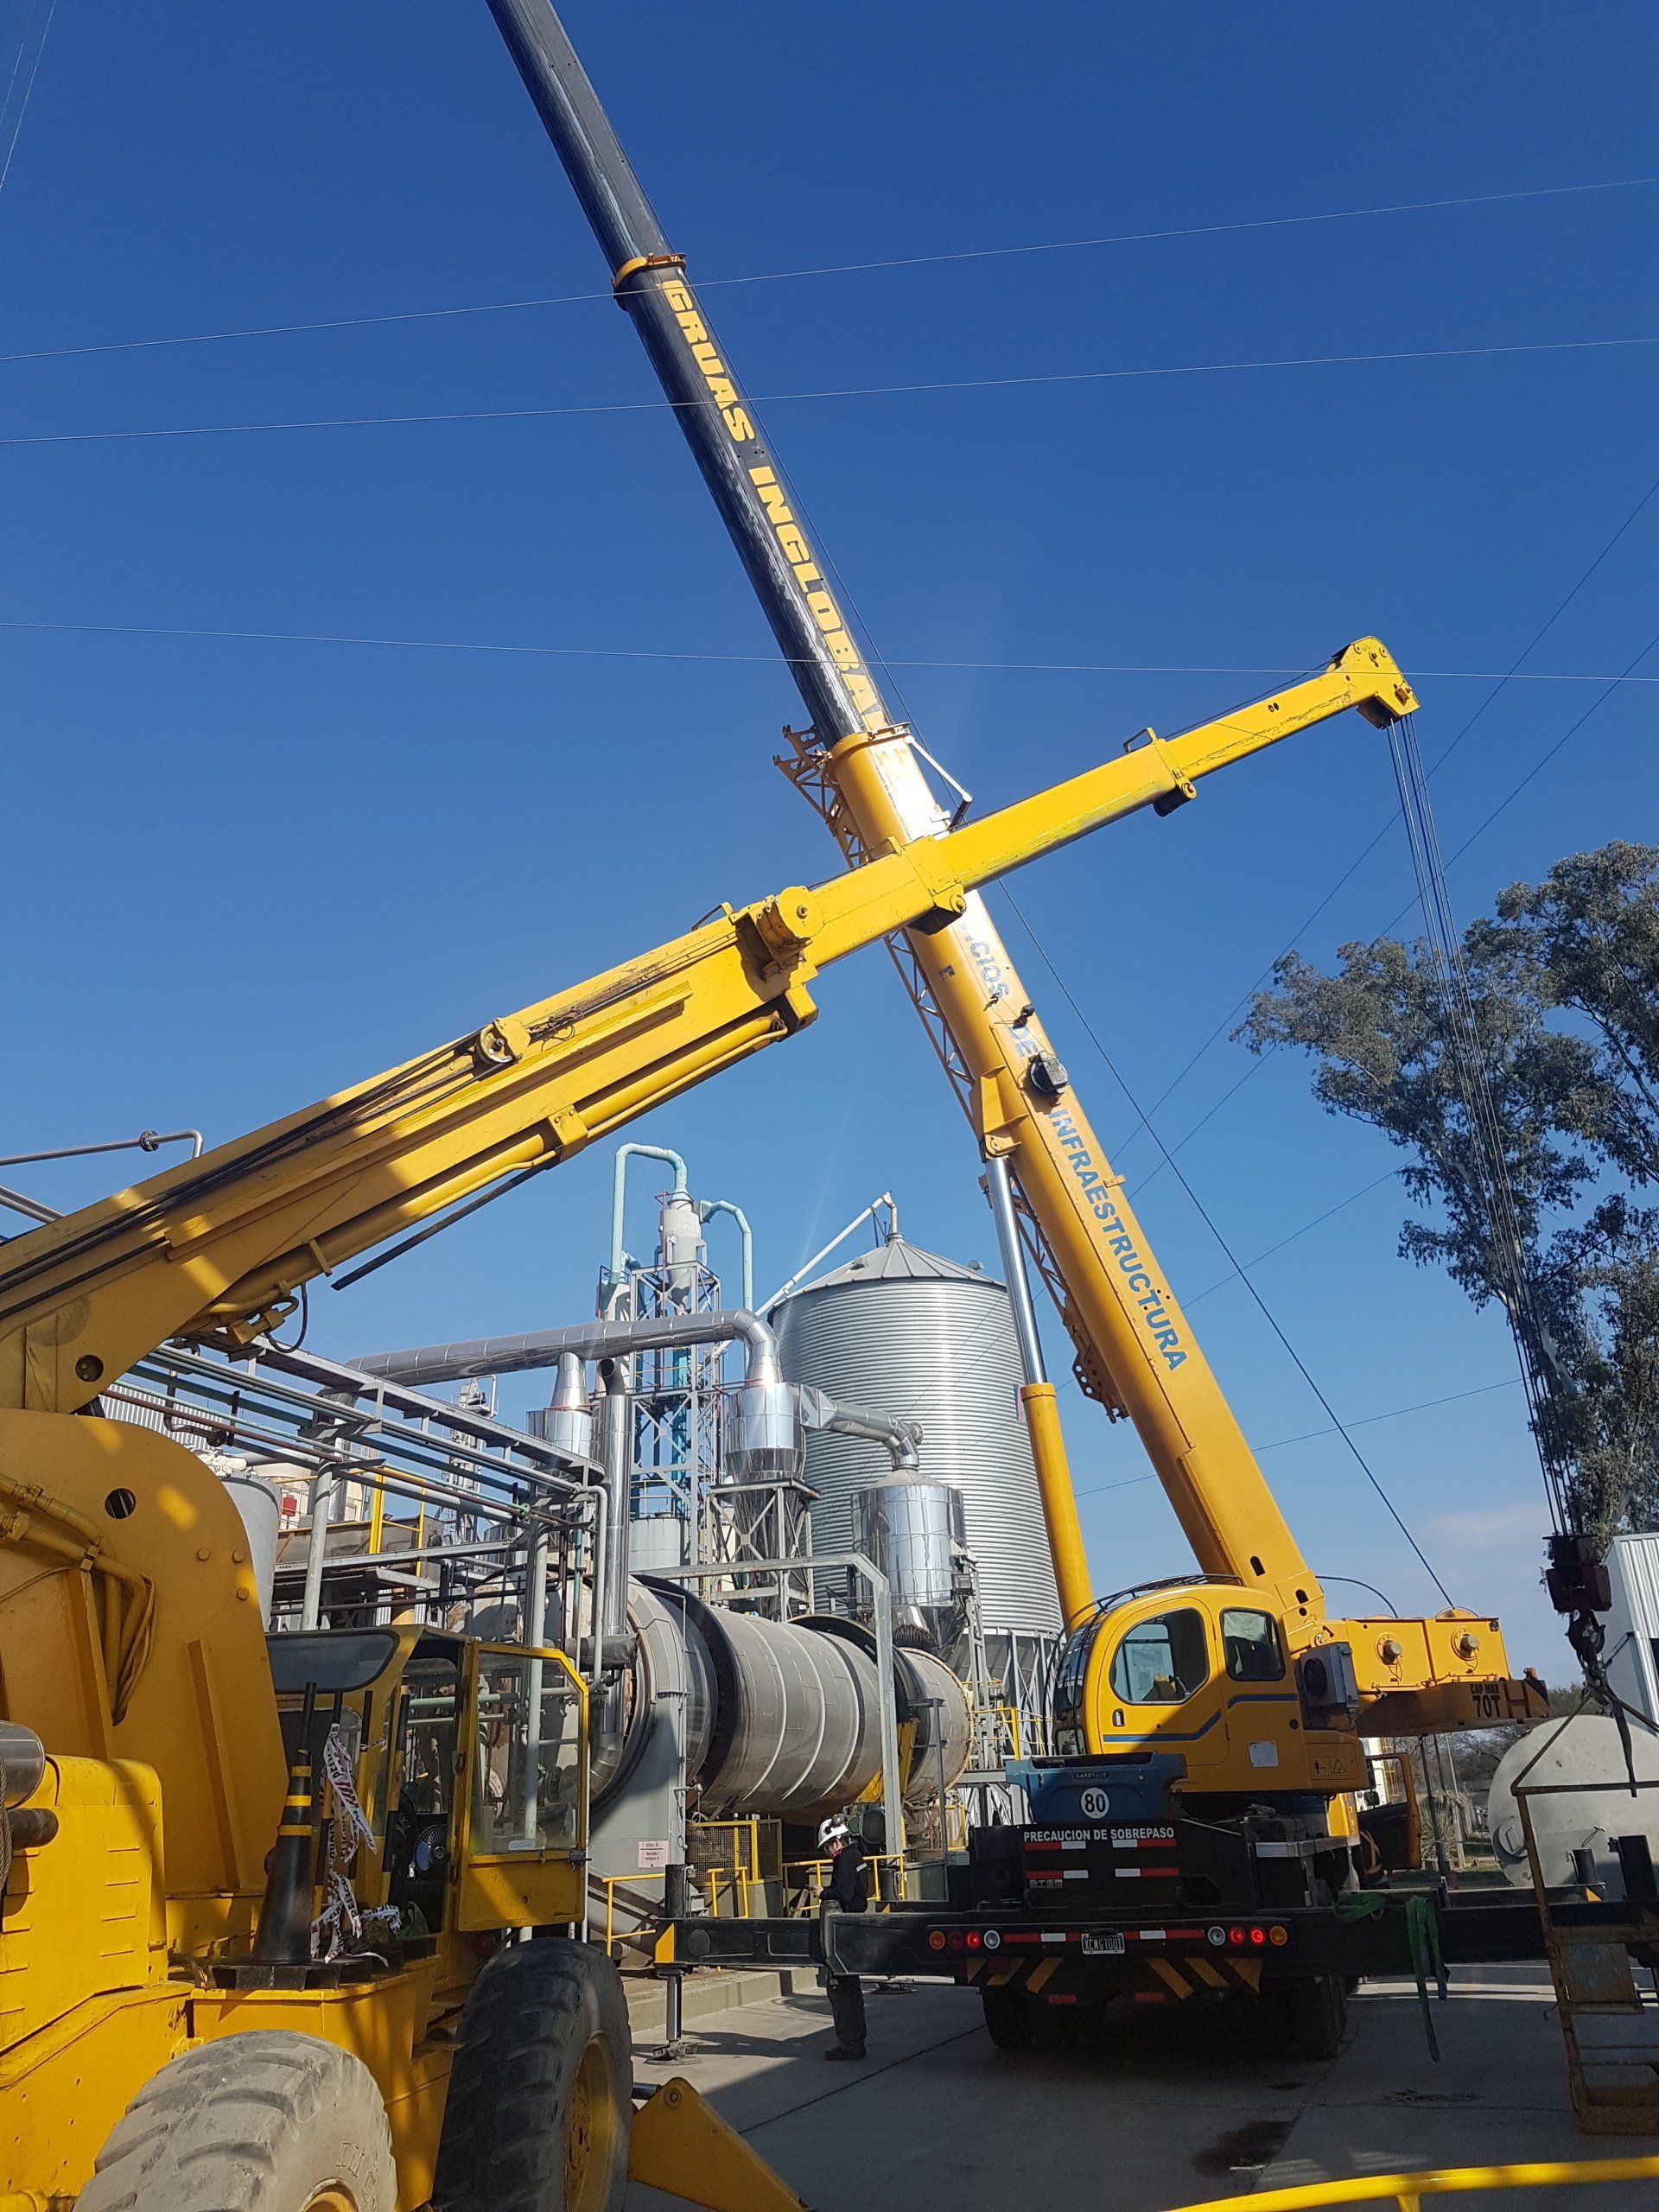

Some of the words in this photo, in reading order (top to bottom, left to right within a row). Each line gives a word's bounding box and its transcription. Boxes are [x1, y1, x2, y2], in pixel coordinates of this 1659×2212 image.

[662, 279, 755, 442] GRUAS
[1048, 1108, 1187, 1371] INFRAESTRUCTURA
[1472, 1694, 1501, 1718] 70T
[1084, 1793, 1106, 1813] 80
[1024, 1829, 1090, 1842] PRECAUCION
[1094, 1829, 1108, 1840] DE
[1110, 1827, 1174, 1839] SOBREPASO
